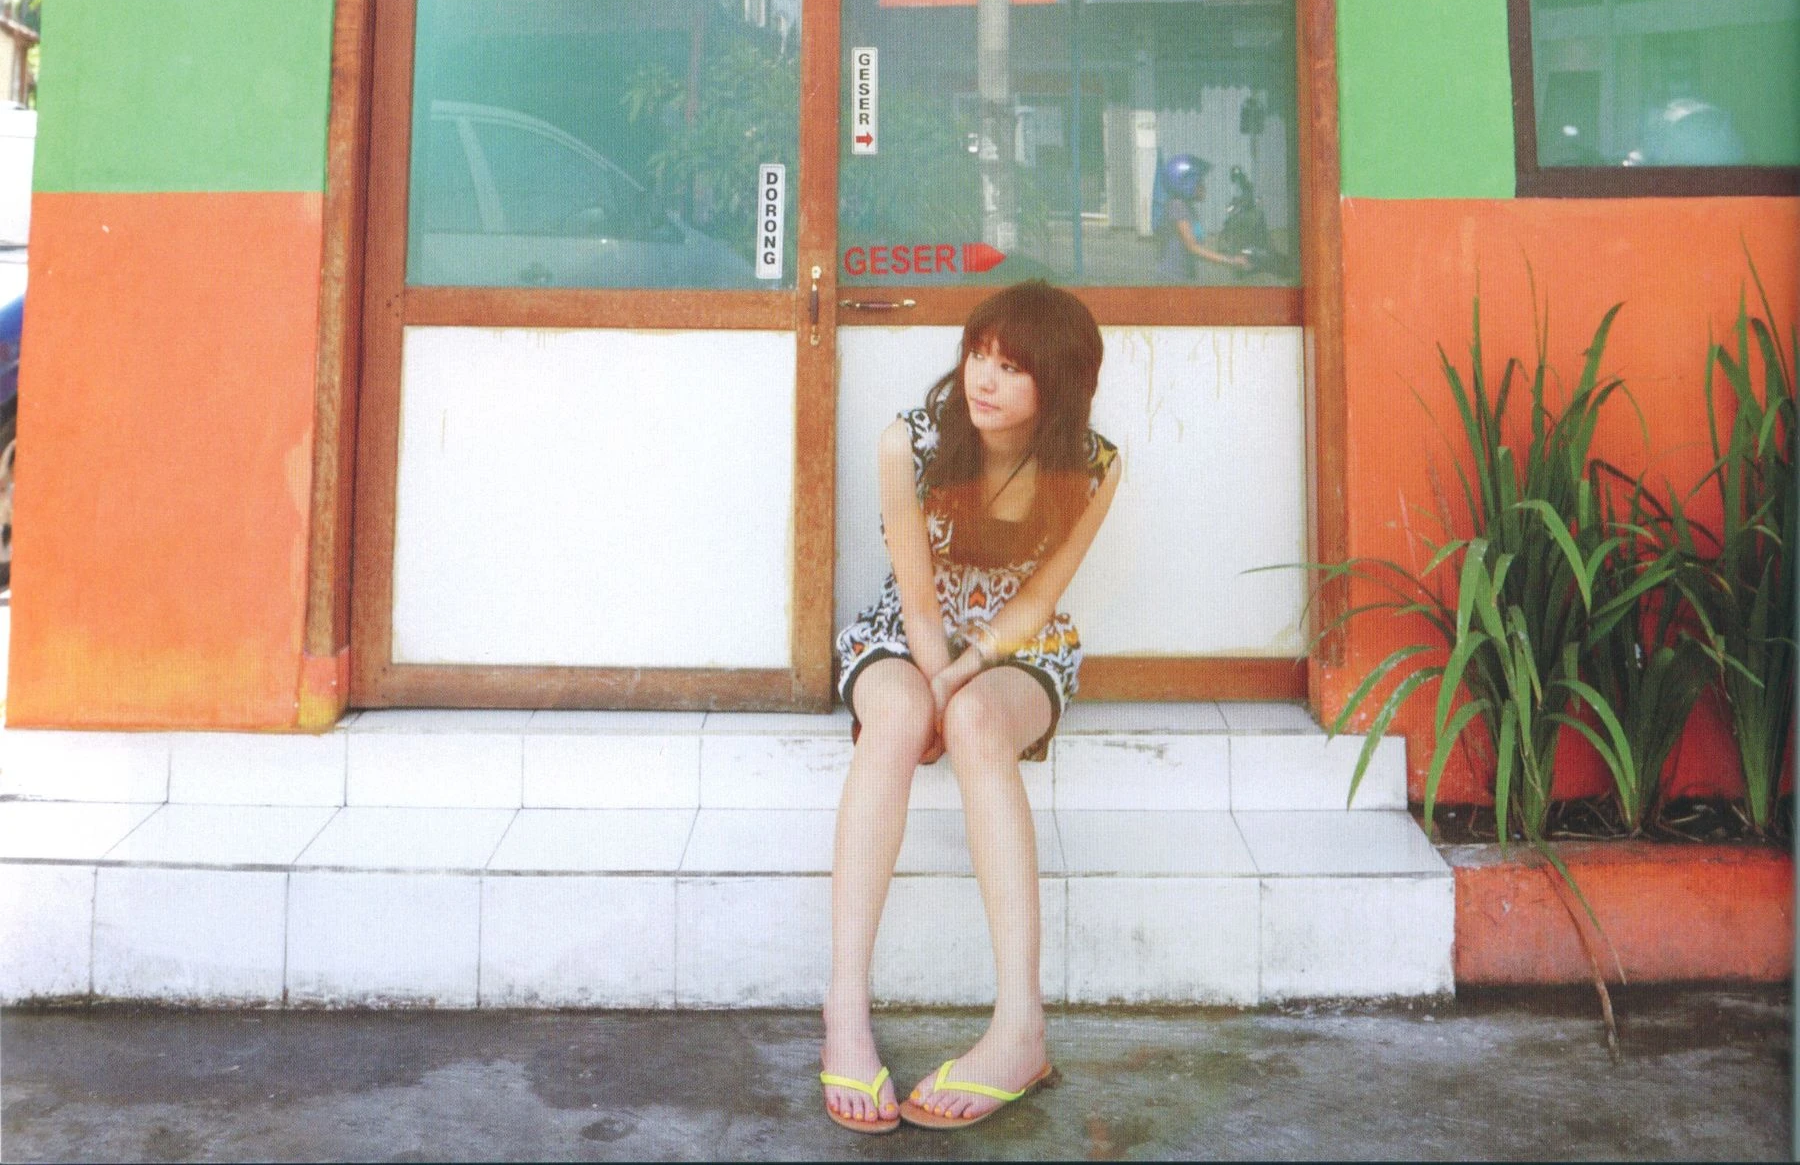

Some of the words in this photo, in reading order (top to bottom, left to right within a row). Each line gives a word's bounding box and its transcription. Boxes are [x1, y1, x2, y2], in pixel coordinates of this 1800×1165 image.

[858, 53, 871, 125] GESER
[763, 172, 778, 265] DORONG
[843, 244, 957, 276] GESER
